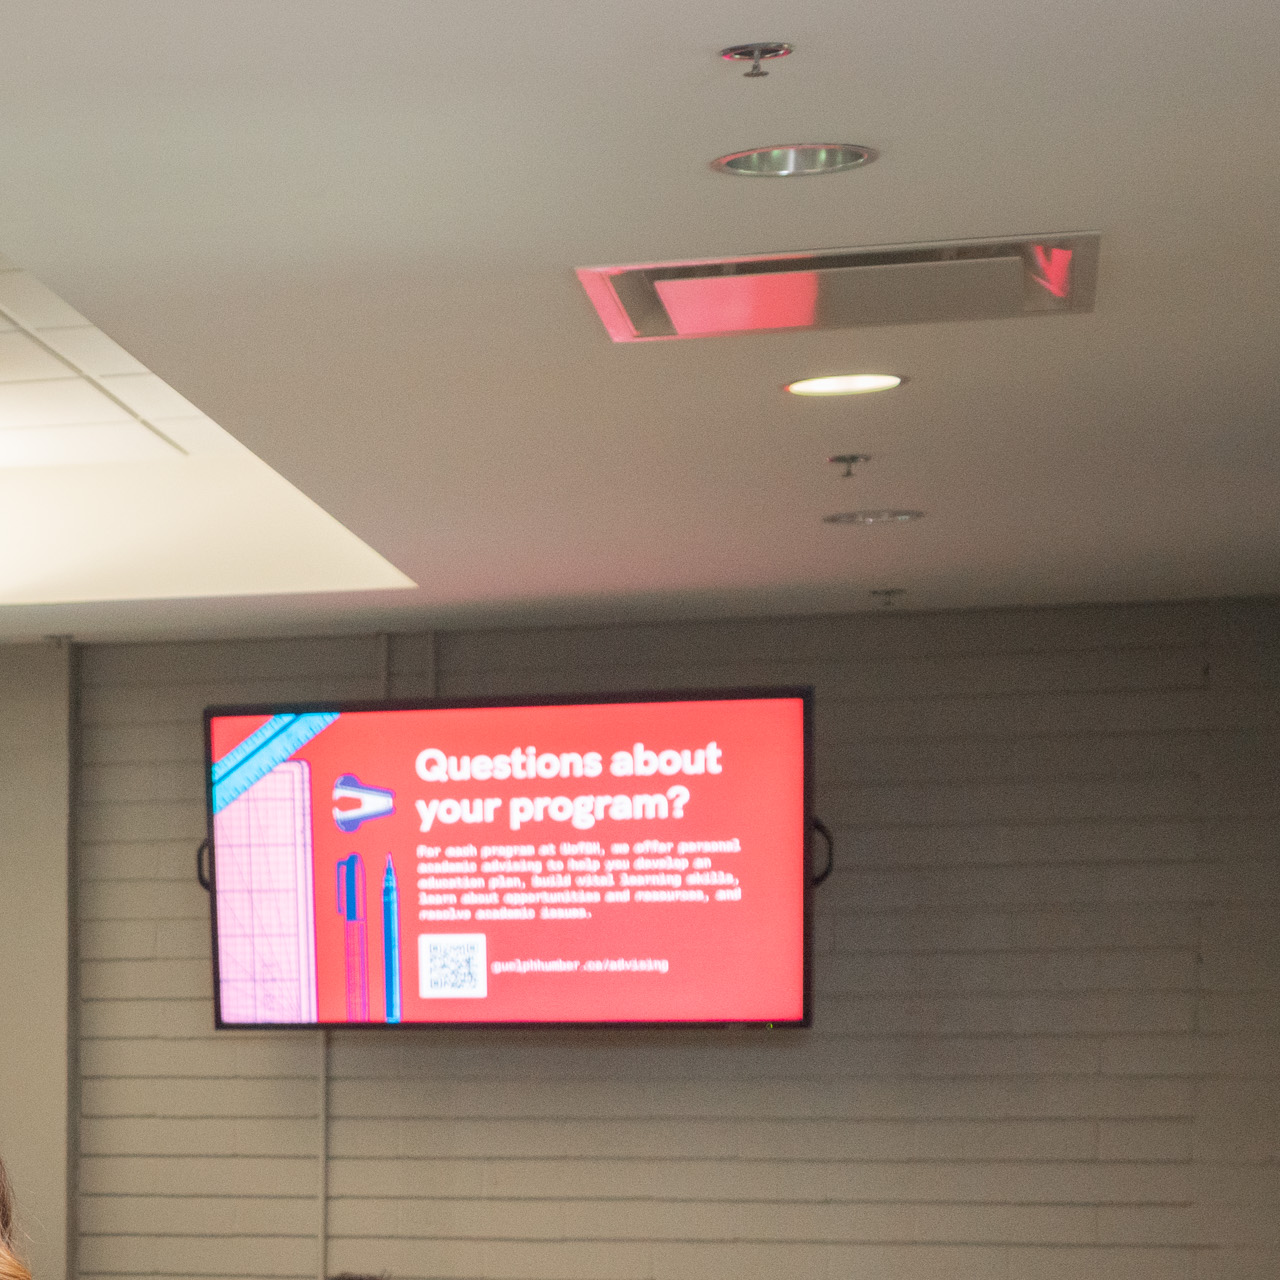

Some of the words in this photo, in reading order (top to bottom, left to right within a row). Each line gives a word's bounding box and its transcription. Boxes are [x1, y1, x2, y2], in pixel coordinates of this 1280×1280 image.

[414, 746, 604, 783] Questions
[609, 741, 724, 777] about
[414, 797, 503, 833] your
[509, 784, 691, 831] program?
